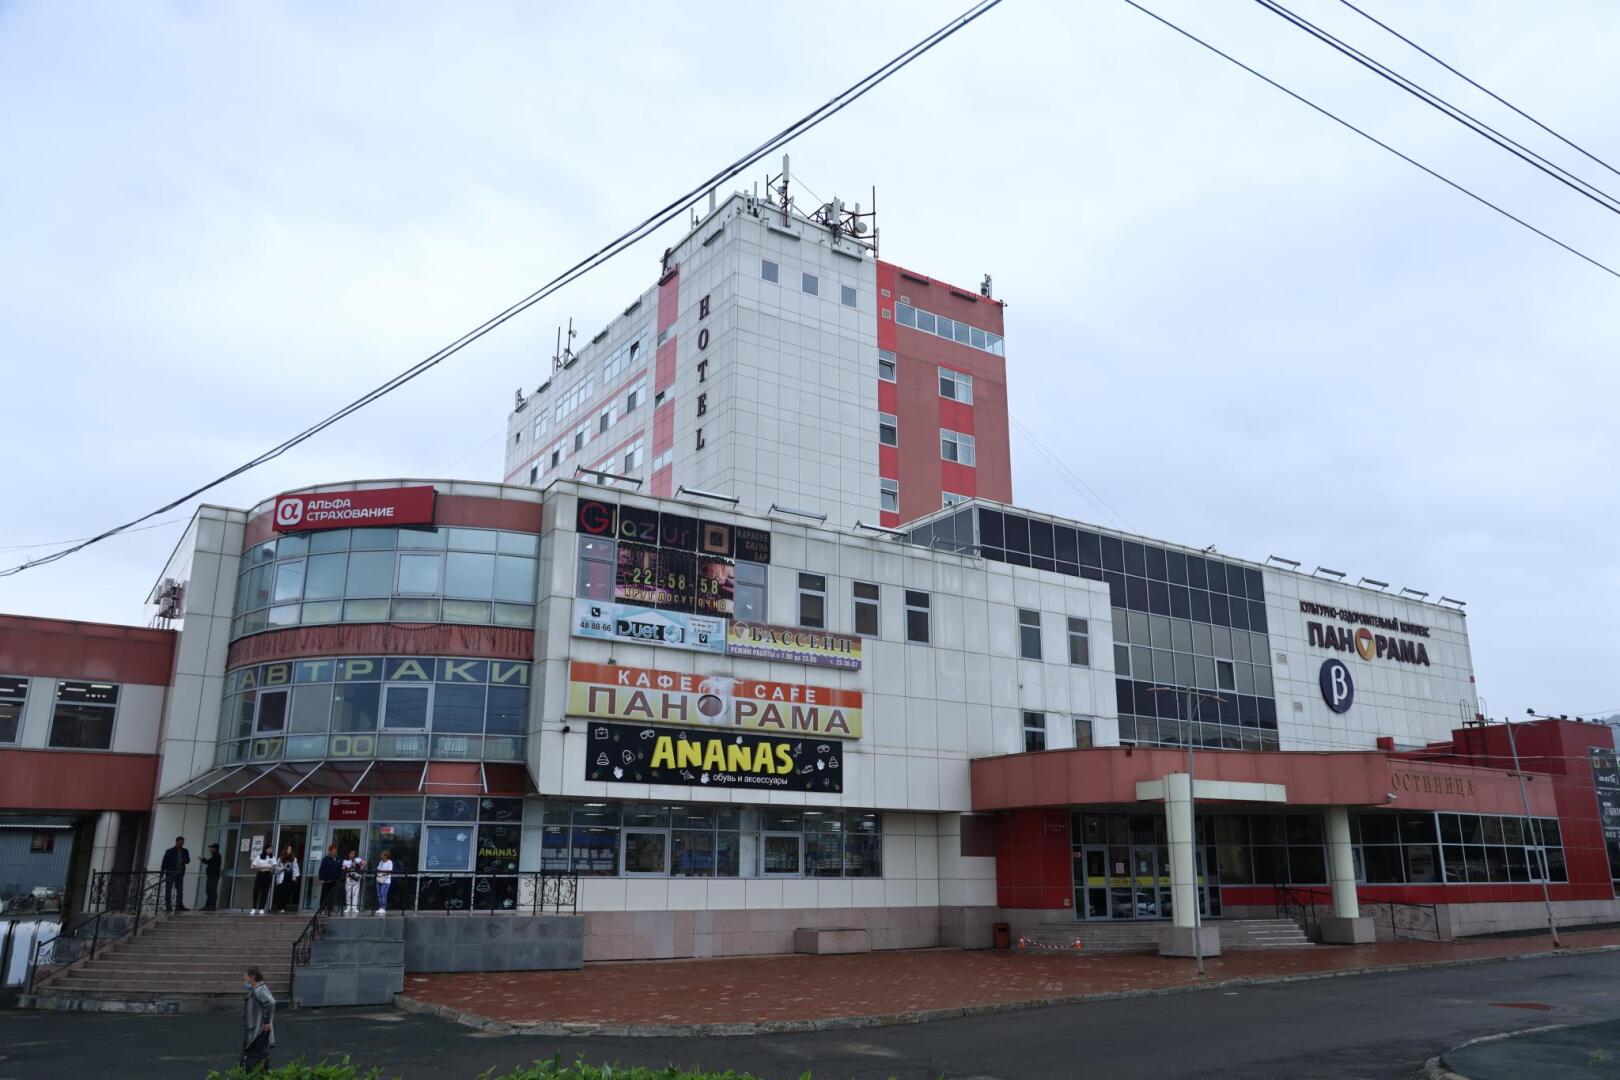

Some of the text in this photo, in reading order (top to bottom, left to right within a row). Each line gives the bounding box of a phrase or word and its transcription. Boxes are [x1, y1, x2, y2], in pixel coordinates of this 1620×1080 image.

[695, 293, 711, 451] HOTEL
[306, 506, 395, 522] СТРАХОВАНИЕ
[307, 498, 351, 511] АЛЬФА
[579, 501, 690, 547] Glazur
[618, 621, 660, 640] Duet
[751, 626, 852, 653] БАССЕЙН
[1307, 620, 1431, 667] ПАНОРАМА
[617, 669, 692, 692] КАФЕ
[754, 684, 816, 703] CAFE
[588, 685, 851, 734] ПАНОРАМА
[650, 735, 794, 775] ANANAS
[713, 773, 736, 784] обувь
[744, 776, 788, 786] аксессуары
[1391, 772, 1474, 799] ОСТИНИЦА
[478, 847, 518, 857] ANANAS
